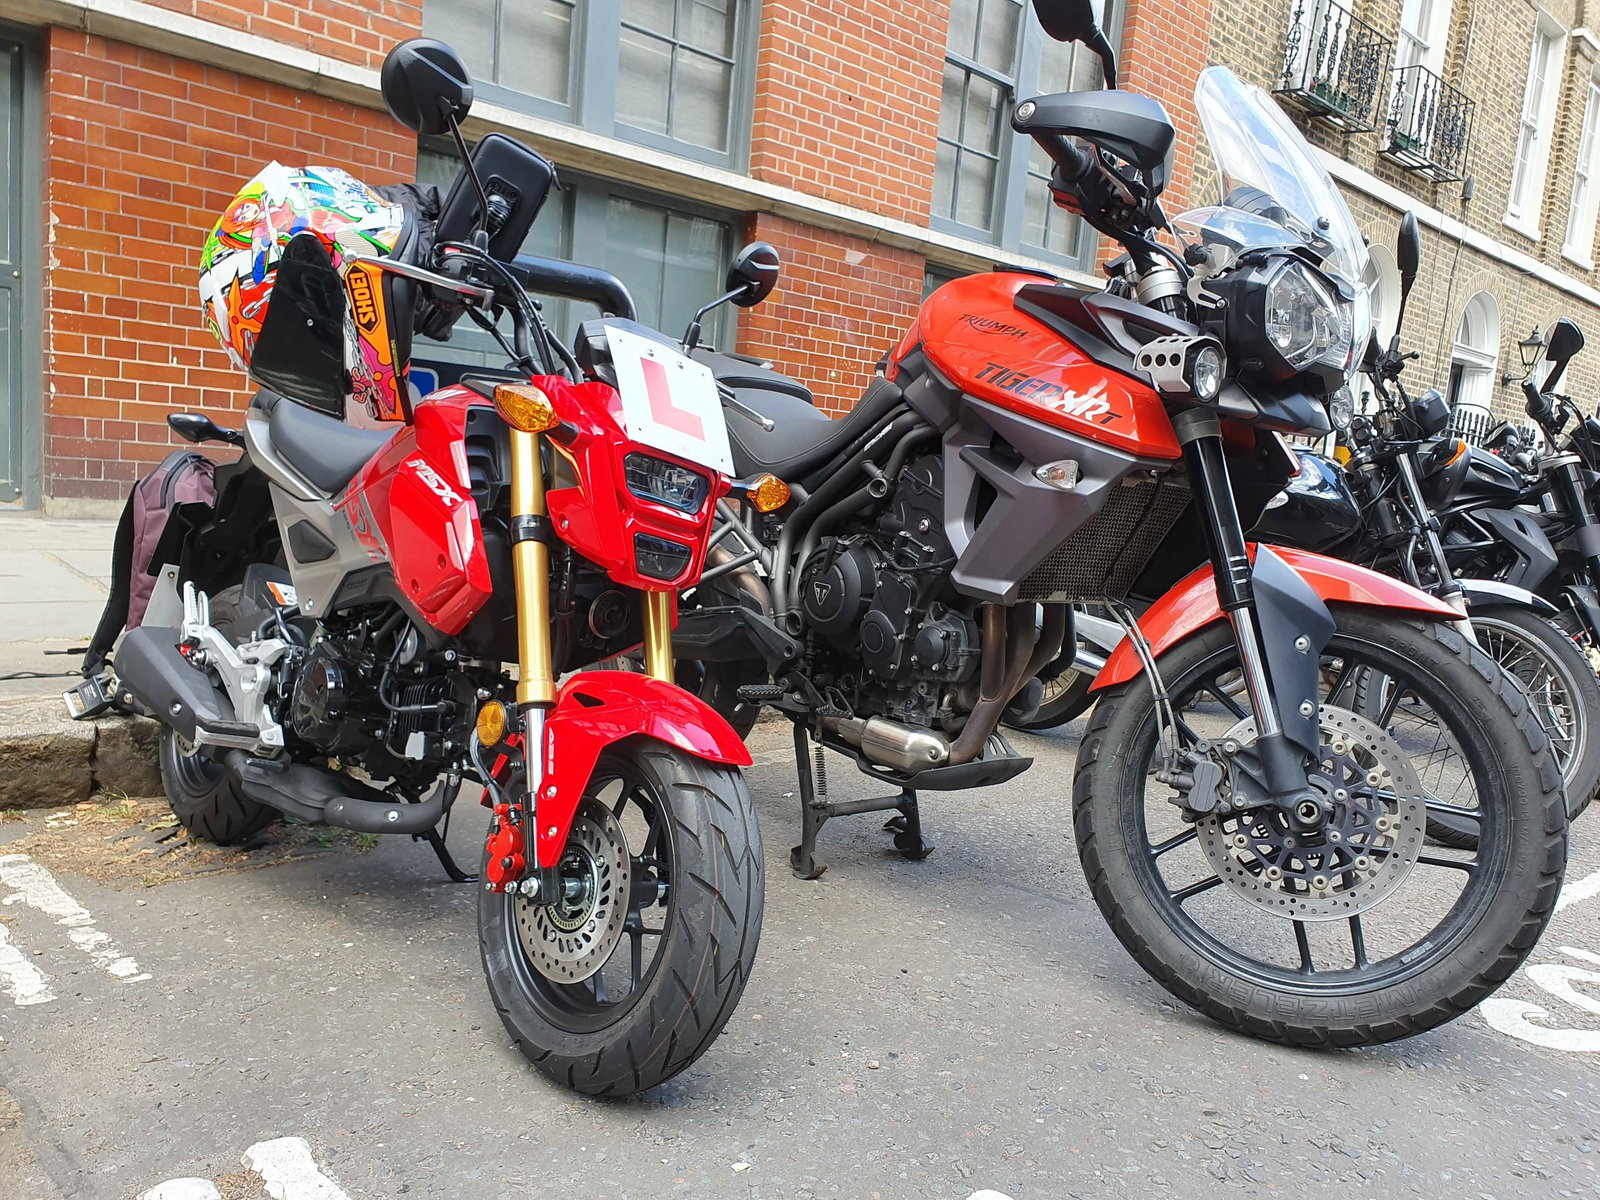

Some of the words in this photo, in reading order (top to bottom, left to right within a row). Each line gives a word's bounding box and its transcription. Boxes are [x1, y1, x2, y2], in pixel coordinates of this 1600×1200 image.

[350, 273, 376, 326] SHOEI
[958, 313, 1030, 339] TRIUMPH
[640, 357, 706, 441] L
[405, 459, 464, 507] MSX
[1203, 966, 1418, 1022] METZELER
